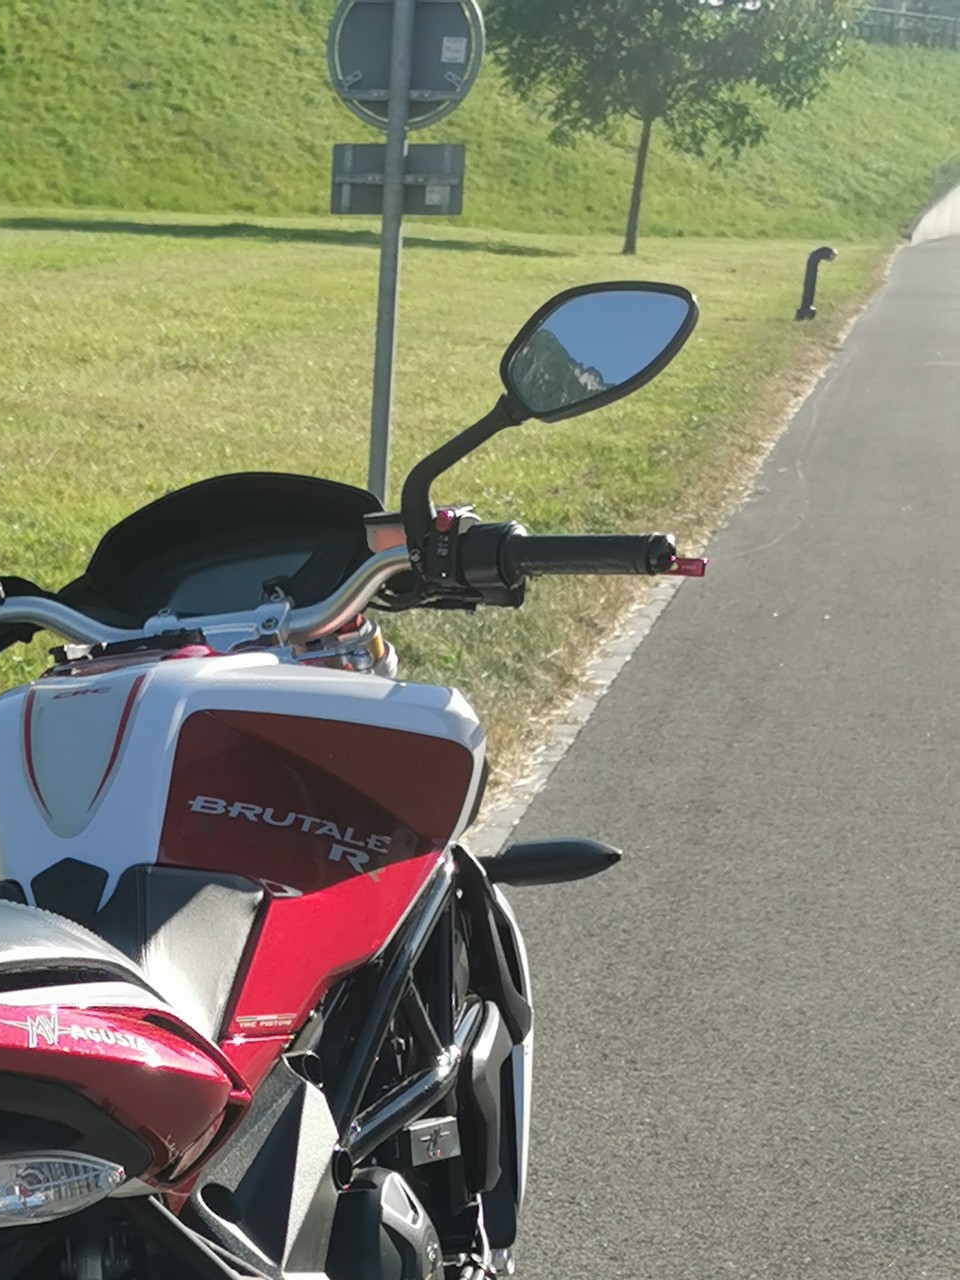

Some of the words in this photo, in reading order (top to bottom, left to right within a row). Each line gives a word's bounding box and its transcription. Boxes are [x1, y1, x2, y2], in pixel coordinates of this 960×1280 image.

[188, 794, 393, 855] BRUTALE
[327, 842, 384, 883] R
[70, 1024, 149, 1051] AGUSTA
